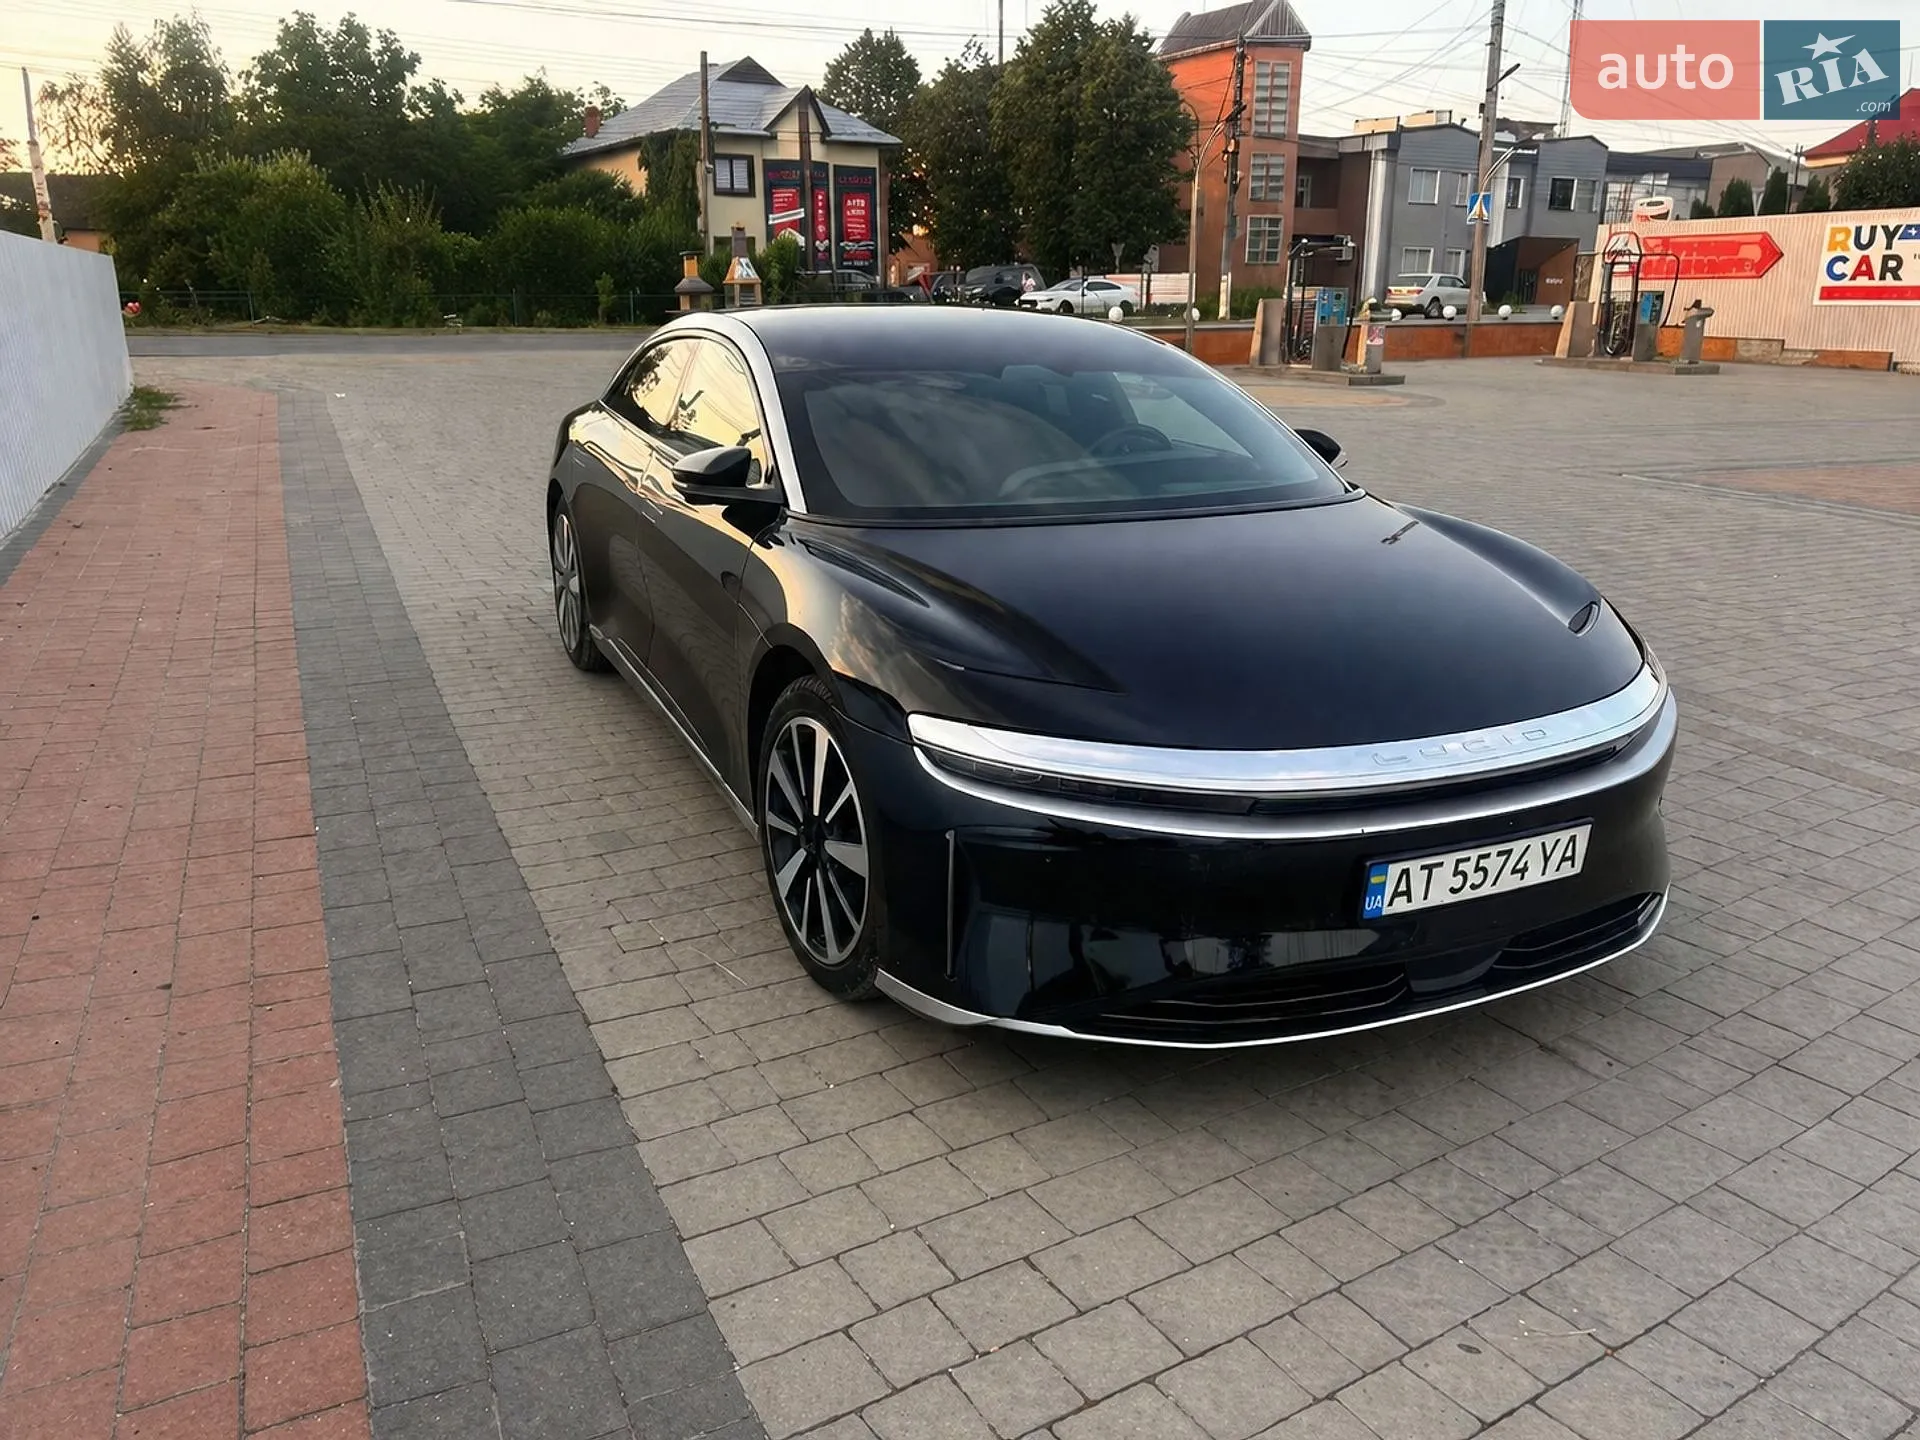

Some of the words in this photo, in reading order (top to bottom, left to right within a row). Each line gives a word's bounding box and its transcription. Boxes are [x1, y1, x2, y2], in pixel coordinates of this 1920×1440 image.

[1826, 254, 1904, 281] CAR
[1387, 861, 1444, 907] AT
[1449, 844, 1532, 895] 5574
[1540, 834, 1578, 877] YA
[1364, 895, 1382, 911] UA
